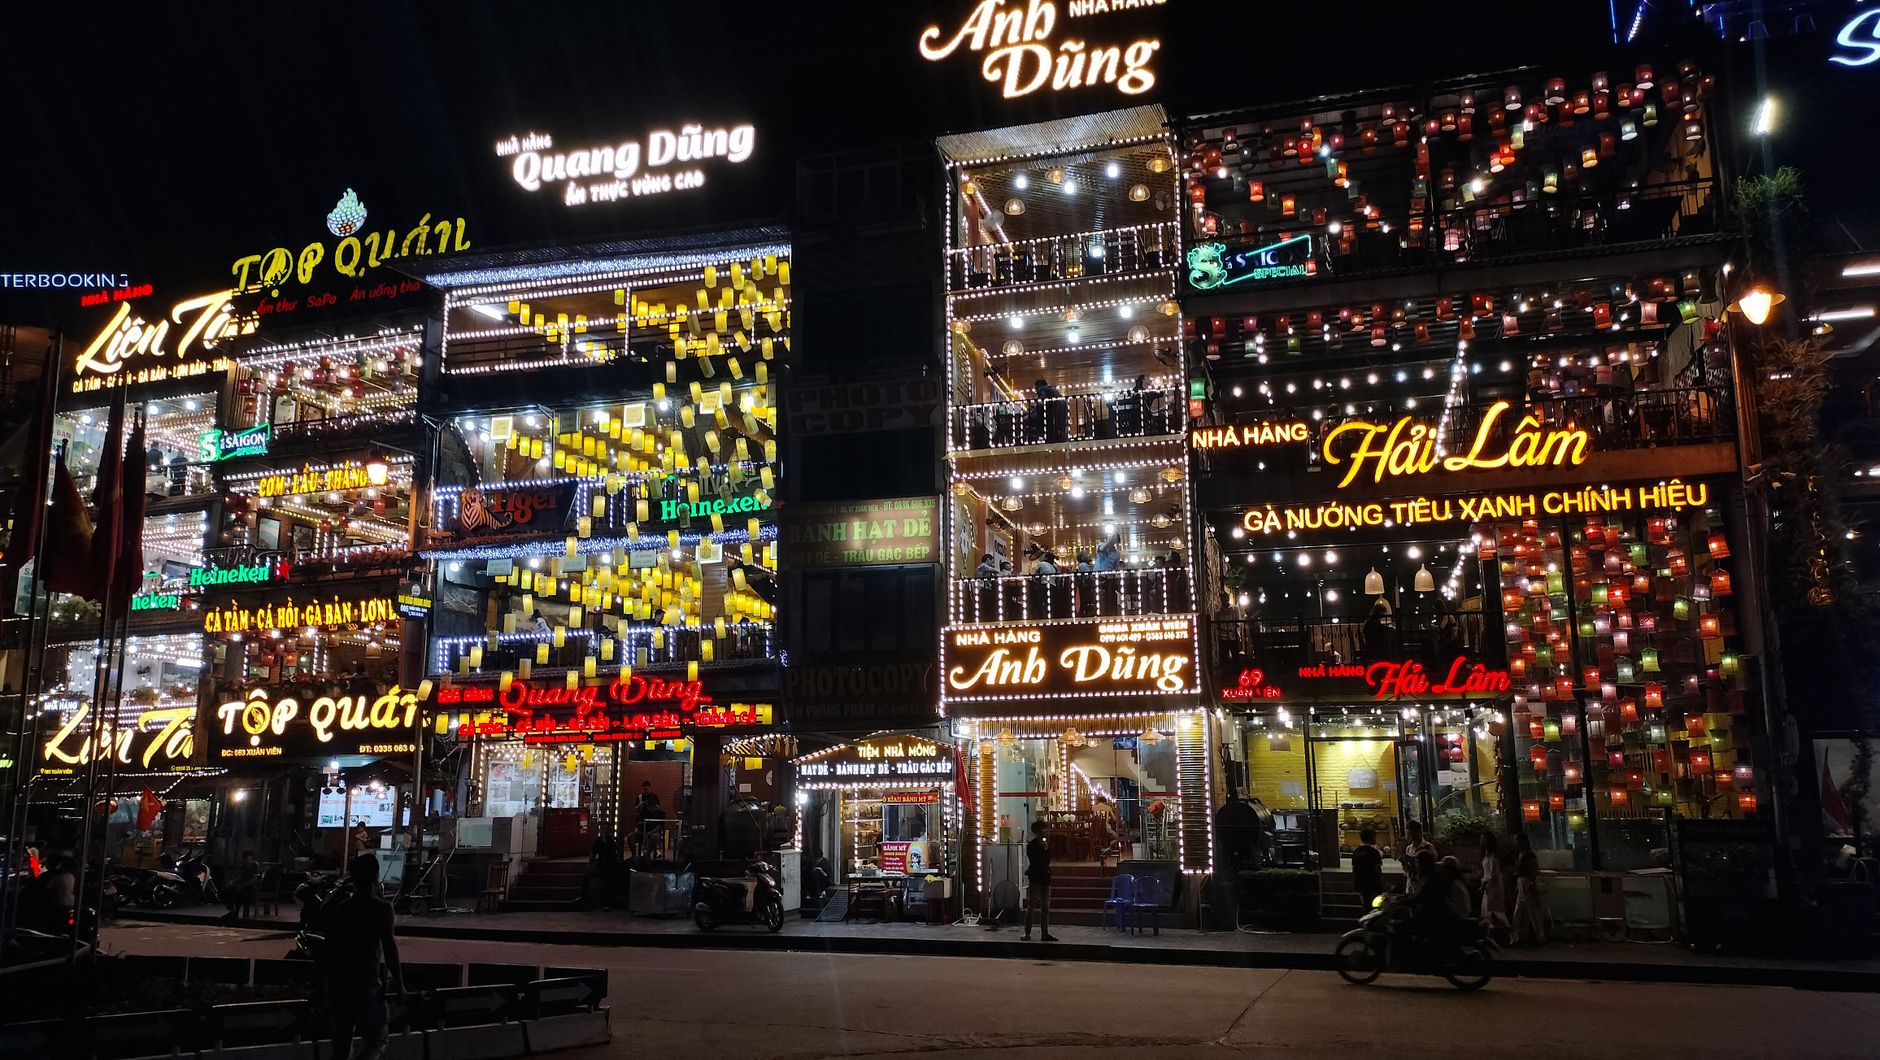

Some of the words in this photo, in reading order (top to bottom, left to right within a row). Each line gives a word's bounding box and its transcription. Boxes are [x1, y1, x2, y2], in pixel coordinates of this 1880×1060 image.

[919, 0, 1056, 60] Anh
[982, 37, 1160, 98] Dũng
[496, 135, 518, 156] NHÀ
[522, 131, 552, 152] HÀNG
[513, 142, 640, 191] Quang
[648, 123, 754, 167] Dũng
[590, 178, 628, 202] THỰC
[632, 173, 671, 197] VÙNG
[675, 169, 705, 190] CAO
[334, 212, 471, 278] QUÁN
[1253, 264, 1308, 280] SPECIAL
[306, 291, 338, 309] SaPa
[76, 301, 169, 376] Liên
[787, 378, 938, 411] PHOTO
[790, 403, 939, 434] COPY
[1192, 427, 1241, 448] NHÀ
[1243, 422, 1308, 445] HÀNG
[1323, 416, 1438, 488] Hải
[1444, 403, 1589, 472] Lâm
[258, 475, 286, 497] CƠM
[291, 462, 319, 494] LẨU
[491, 487, 562, 524] Tiger
[1243, 504, 1282, 532] GÀ
[1286, 502, 1383, 530] NƯỚNG
[1390, 497, 1453, 523] TIÊU
[1460, 494, 1536, 521] XANH
[1543, 486, 1632, 514] CHÍNH
[1639, 479, 1707, 511] HIỆU
[789, 519, 847, 543] BÁNH
[853, 519, 897, 544] HẠT
[903, 510, 932, 537] DẺ
[843, 546, 874, 562] TRÂU
[878, 545, 902, 561] GÁC
[906, 542, 930, 559] BẾP
[190, 563, 269, 586] Heineken
[204, 606, 222, 632] CÁ
[224, 598, 250, 631] TẦM
[256, 601, 274, 629] CÁ
[277, 597, 299, 628] HỒI
[306, 601, 322, 627] GÀ
[325, 595, 351, 625] BẢN
[360, 599, 386, 629] LỢN
[956, 630, 990, 646] NHÀ
[994, 629, 1041, 644] HÀNG
[785, 663, 932, 698] PHOTOCOPY
[949, 646, 1046, 690] Anh
[1060, 645, 1188, 692] Dũng
[1239, 668, 1264, 687] 69
[1299, 663, 1325, 677] NHÀ
[1329, 664, 1364, 677] HÀNG
[1365, 659, 1430, 699] Hải
[1431, 656, 1511, 694] Lâm
[59, 699, 78, 710] HÀNG
[500, 680, 606, 716] Quang
[1256, 685, 1281, 698] IÊN
[266, 746, 282, 755] VIÊN
[858, 744, 880, 760] TIỆM
[884, 743, 905, 757] NHÀ
[908, 743, 937, 757] MÔNG
[836, 761, 859, 775] BÁNH
[860, 763, 875, 778] HẠT
[897, 759, 919, 775] TRÂU
[920, 759, 935, 773] GÁC
